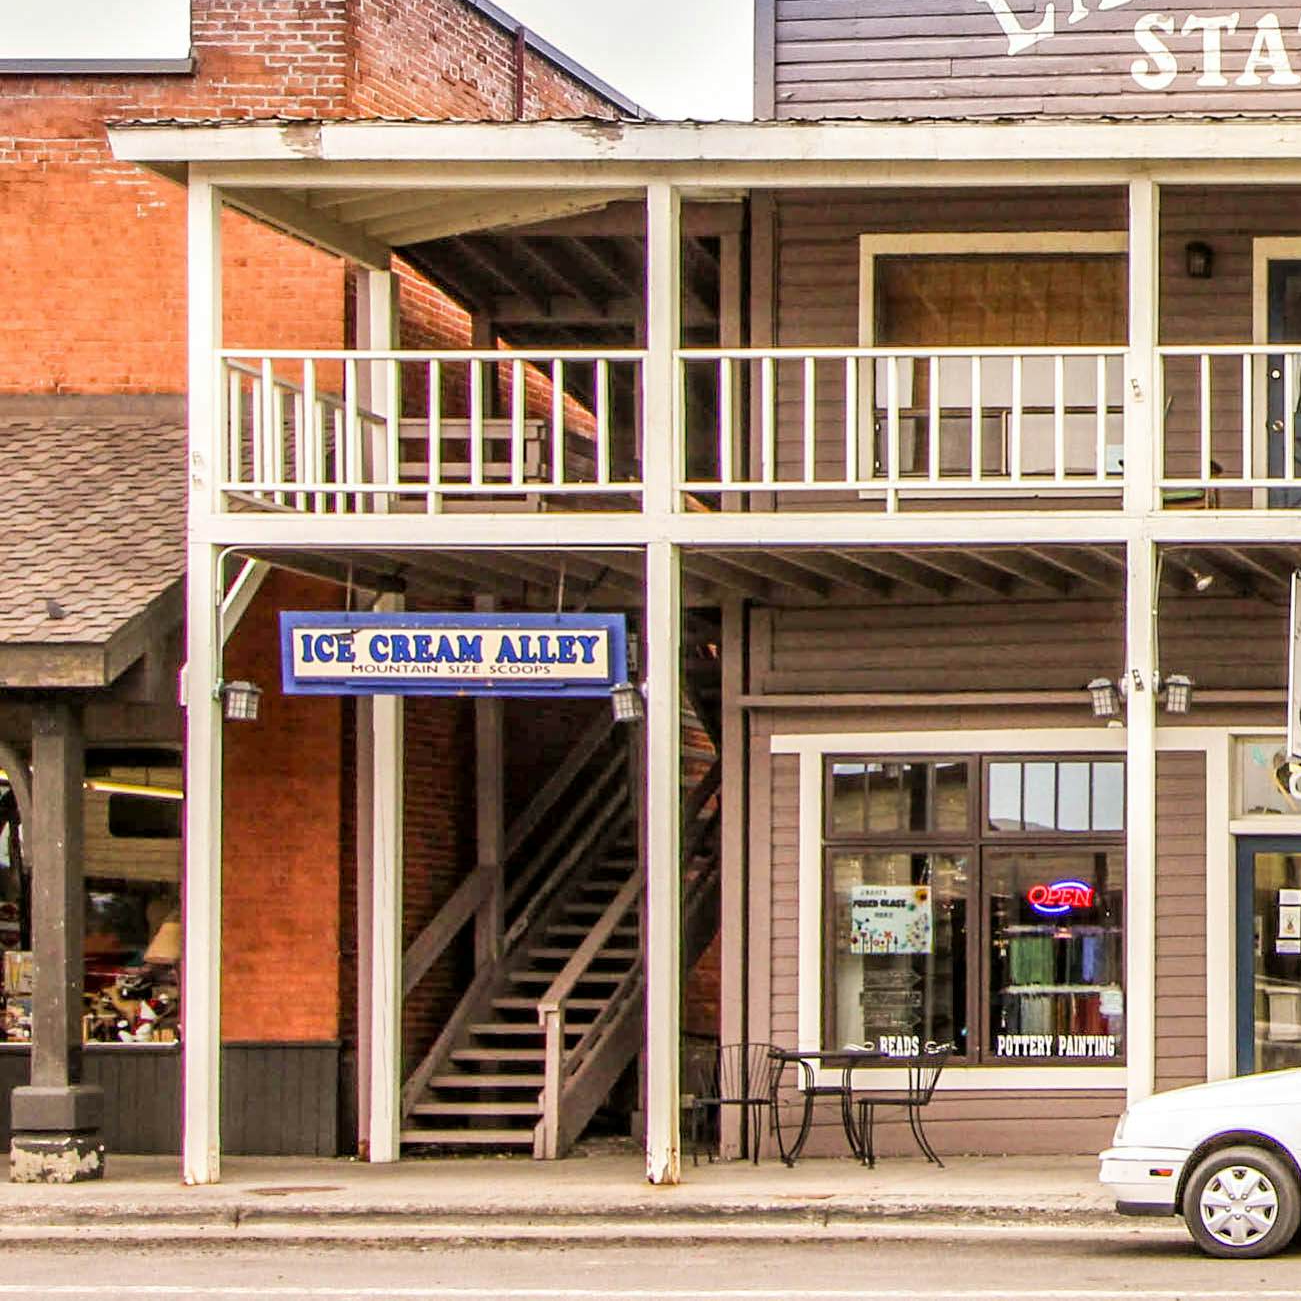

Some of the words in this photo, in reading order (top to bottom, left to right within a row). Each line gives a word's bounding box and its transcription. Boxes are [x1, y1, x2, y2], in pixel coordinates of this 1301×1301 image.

[301, 634, 356, 663] ICE
[369, 634, 484, 663] CREAM
[495, 635, 600, 664] ALLEY
[351, 664, 439, 675] MOUNTAIN
[448, 665, 481, 675] SIZE
[489, 665, 551, 675] SCOOPS
[1027, 885, 1096, 907] OPEN
[879, 1036, 920, 1056] BEADS
[997, 1035, 1053, 1057] POTTERY
[1058, 1035, 1115, 1057] PAINTING
